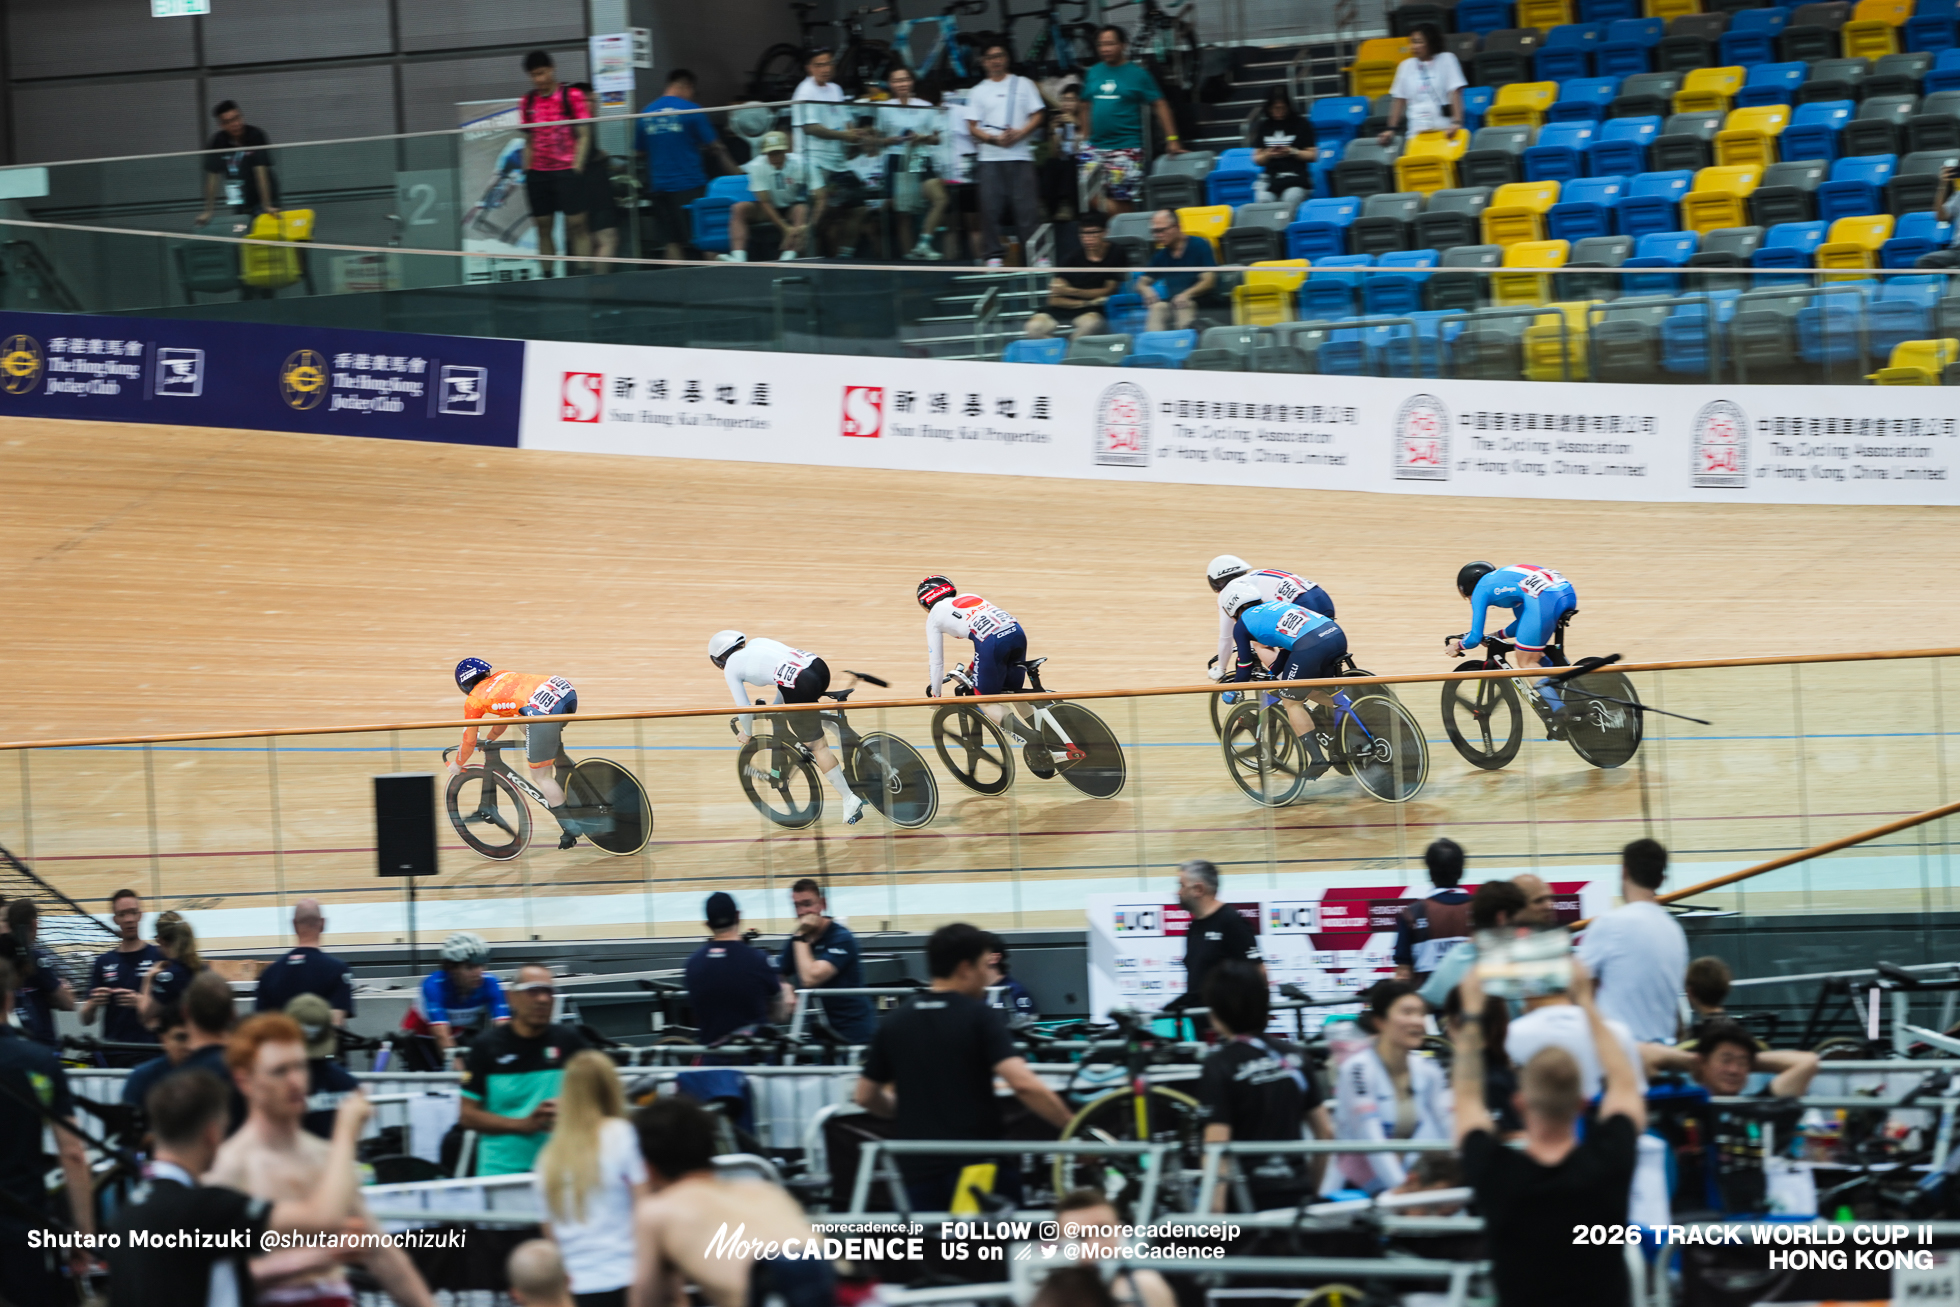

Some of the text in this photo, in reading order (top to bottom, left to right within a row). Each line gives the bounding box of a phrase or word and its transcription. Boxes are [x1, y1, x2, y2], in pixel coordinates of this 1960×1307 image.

[1256, 427, 1335, 444] Association
[1556, 438, 1634, 454] Association
[1854, 443, 1934, 458] Association
[1278, 581, 1298, 600] 358
[973, 615, 995, 635] 391
[1282, 612, 1304, 630] 387
[776, 663, 797, 682] 419
[533, 689, 555, 709] 409
[506, 771, 550, 809] KOGA
